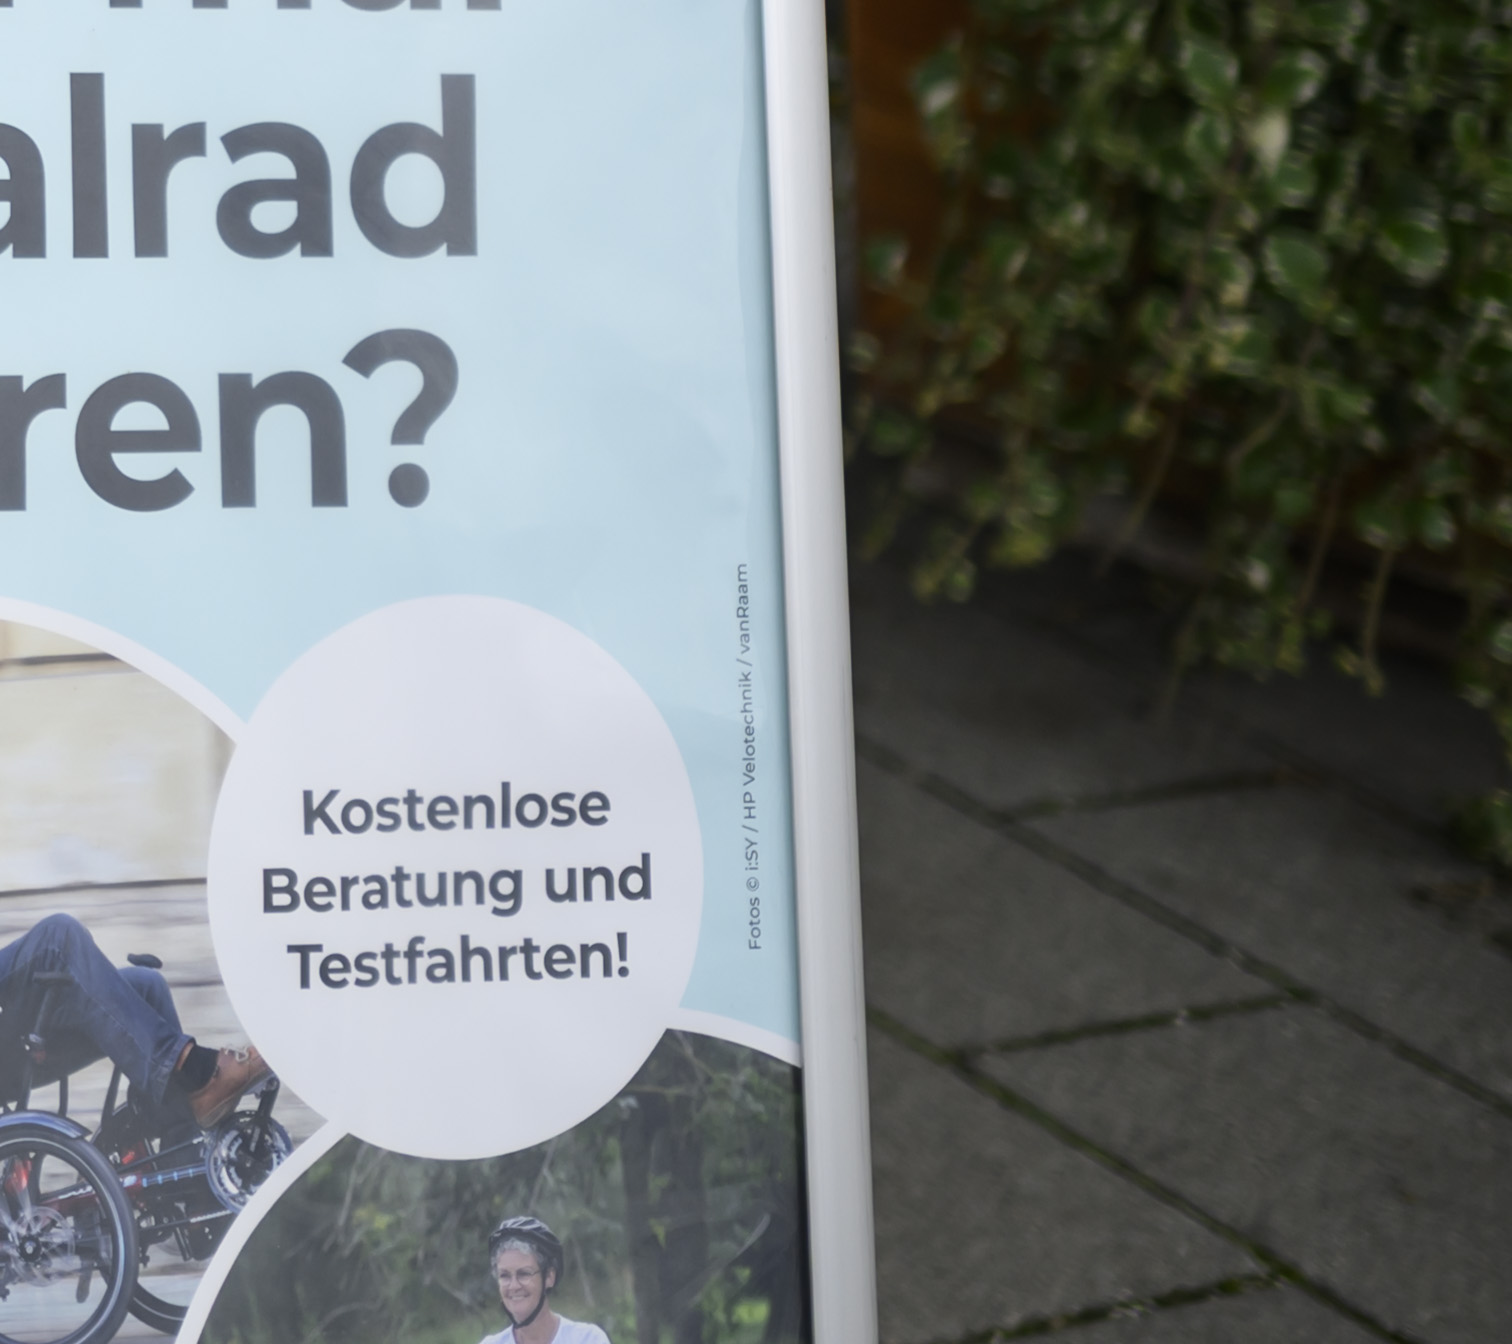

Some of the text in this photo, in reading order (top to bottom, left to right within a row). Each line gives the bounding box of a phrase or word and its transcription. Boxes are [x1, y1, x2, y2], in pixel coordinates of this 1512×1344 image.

[736, 564, 750, 654] vanRaam
[738, 671, 756, 787] Velotechnik
[303, 782, 610, 834] Kostenlose
[742, 791, 756, 820] HP
[744, 837, 759, 871] i:SY
[263, 853, 651, 917] Beratung und
[748, 896, 762, 950] Fotos
[287, 932, 629, 989] Testfahrten!
